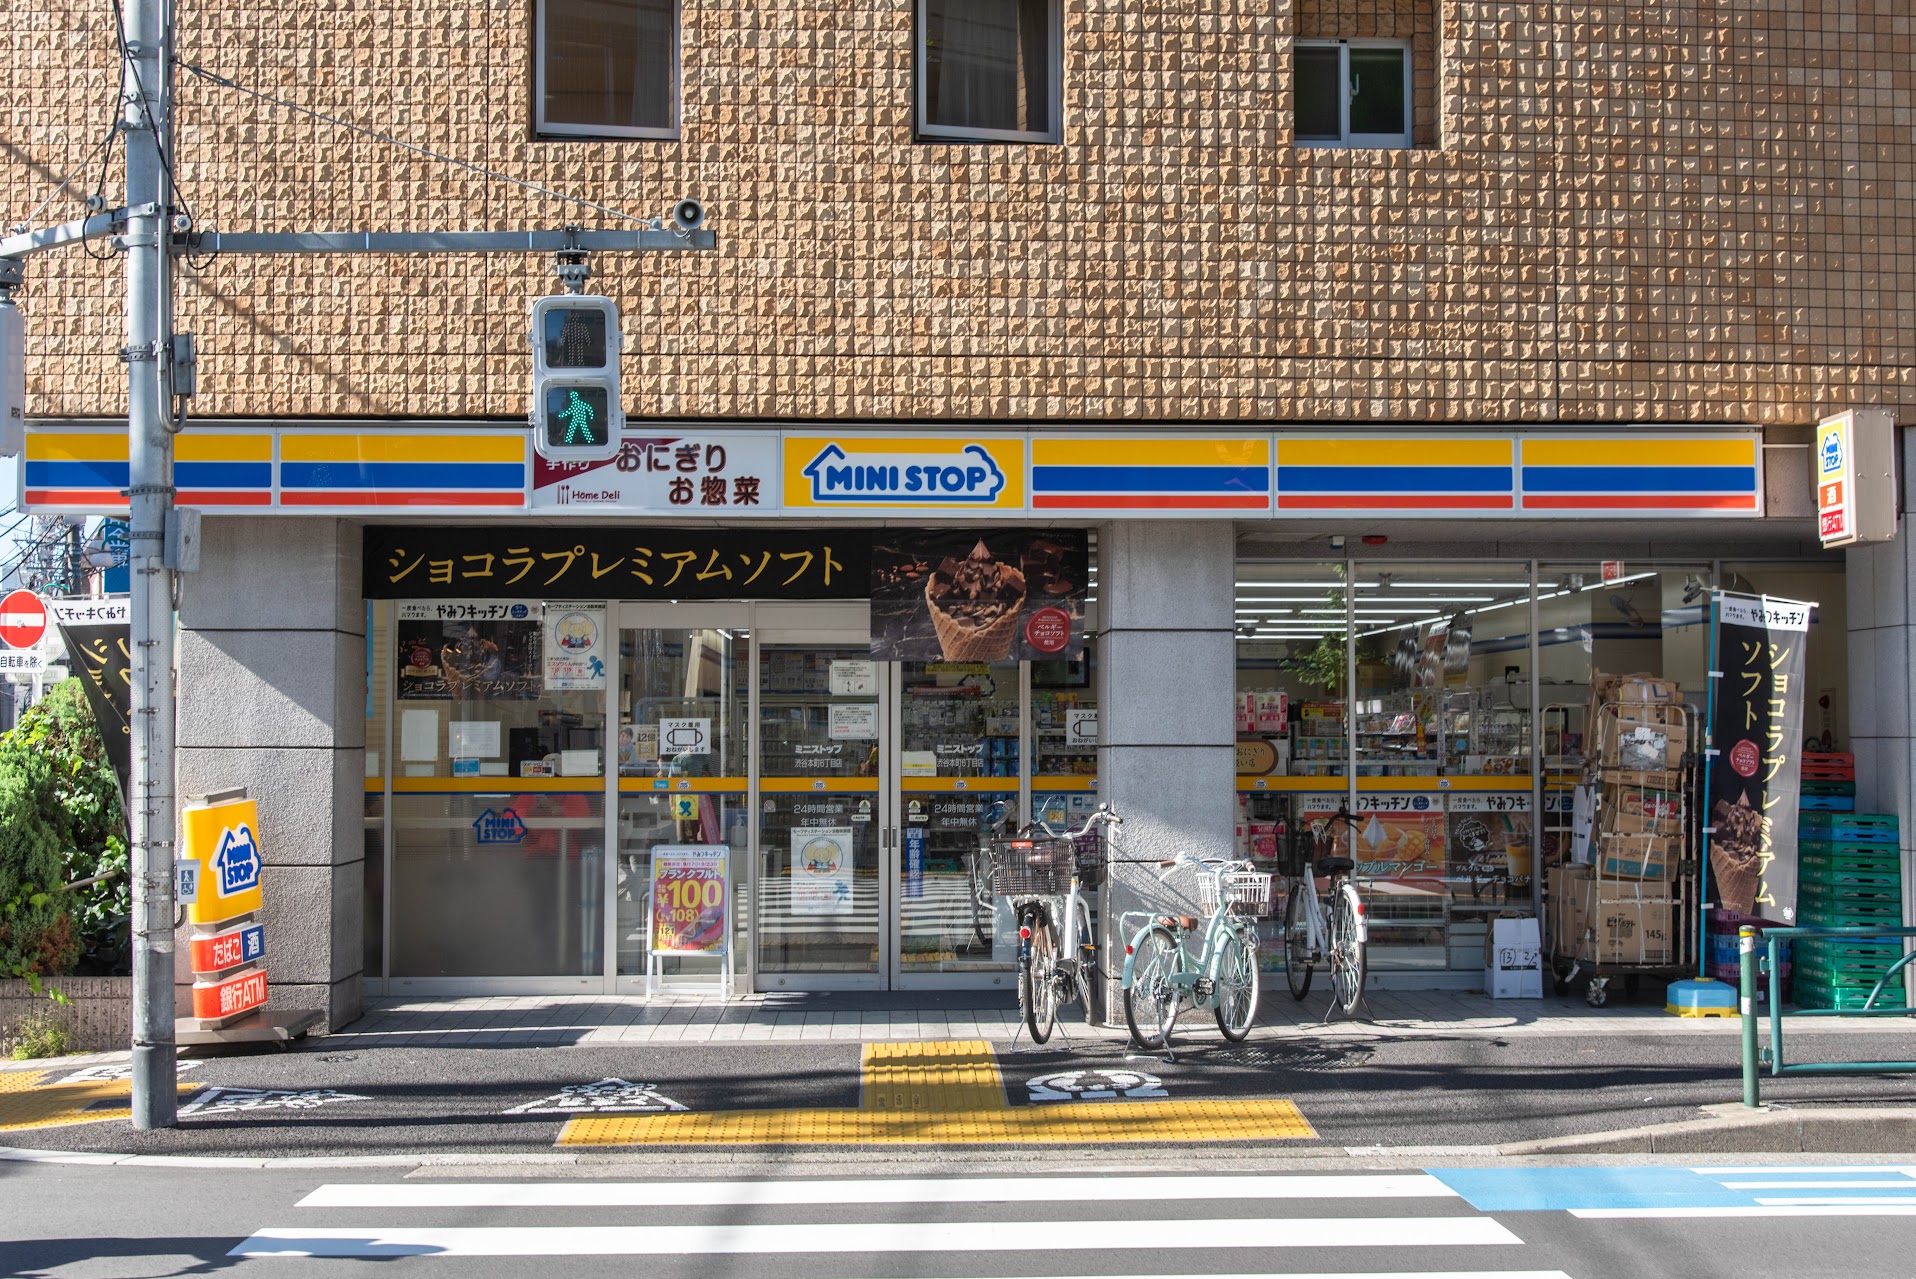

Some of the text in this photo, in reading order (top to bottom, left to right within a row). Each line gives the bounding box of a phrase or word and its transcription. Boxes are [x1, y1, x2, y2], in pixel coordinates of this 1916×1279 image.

[1826, 442, 1838, 454] MINI
[616, 444, 727, 473] おにぎり
[1825, 455, 1839, 467] STOP
[827, 465, 987, 492] MINI STOP
[572, 490, 620, 500] Home Deli
[668, 476, 761, 506] お惣菜
[1827, 486, 1837, 504] 酒
[388, 544, 844, 588] ショコラプレミアムソフト
[436, 604, 509, 619] やみつキッチン
[1750, 608, 1805, 625] やみつキッチン
[0, 655, 43, 669] 自転車を除く
[1741, 640, 1763, 731] ソフト
[795, 744, 843, 755] ミニストップ
[936, 744, 985, 755] ミニストップ
[1755, 642, 1791, 908] ショコラプレミアム
[793, 804, 844, 814] 24時間営業
[934, 803, 984, 814] 24時間営業
[485, 817, 515, 828] MINI
[800, 817, 837, 827] 年中無休
[941, 817, 978, 827] 年中無休
[483, 828, 516, 839] STOP
[226, 841, 252, 866] MINI
[227, 860, 255, 887] STOP
[658, 868, 722, 880] フランクフルト
[212, 930, 260, 968] たばこ 酒
[219, 974, 266, 1014] 銀行ATM
